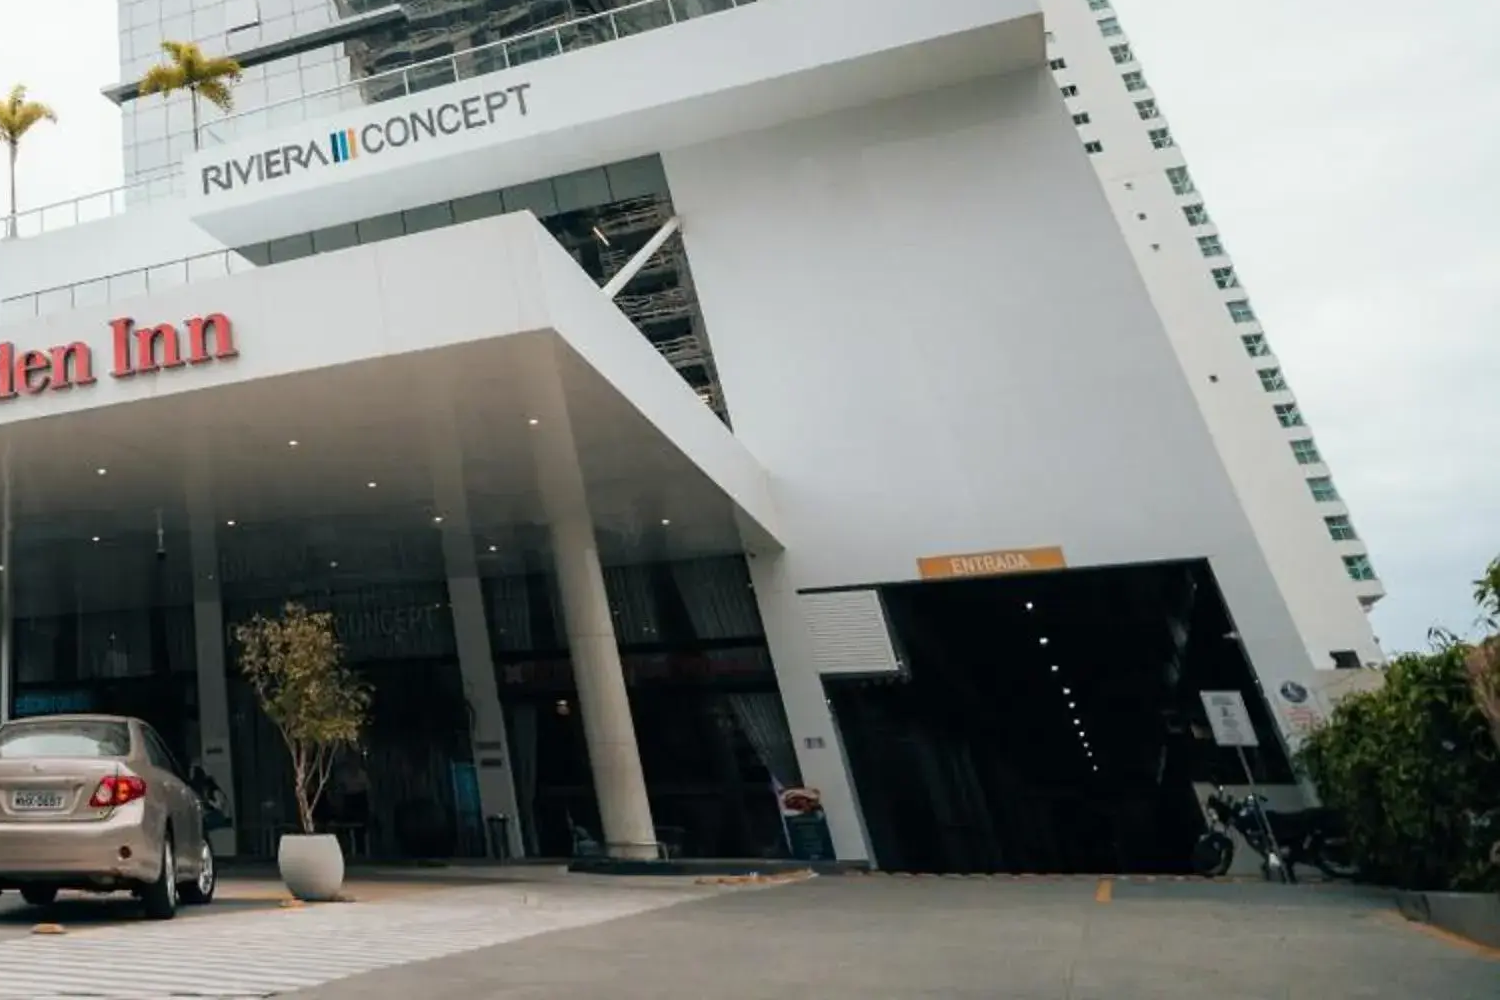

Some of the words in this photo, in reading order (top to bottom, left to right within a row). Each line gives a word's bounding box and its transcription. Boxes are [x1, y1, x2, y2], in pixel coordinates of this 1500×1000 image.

[202, 140, 329, 195] RIVIERA
[361, 83, 532, 154] CONCEPT
[109, 311, 239, 378] Inn
[950, 553, 1031, 573] ENTRADA
